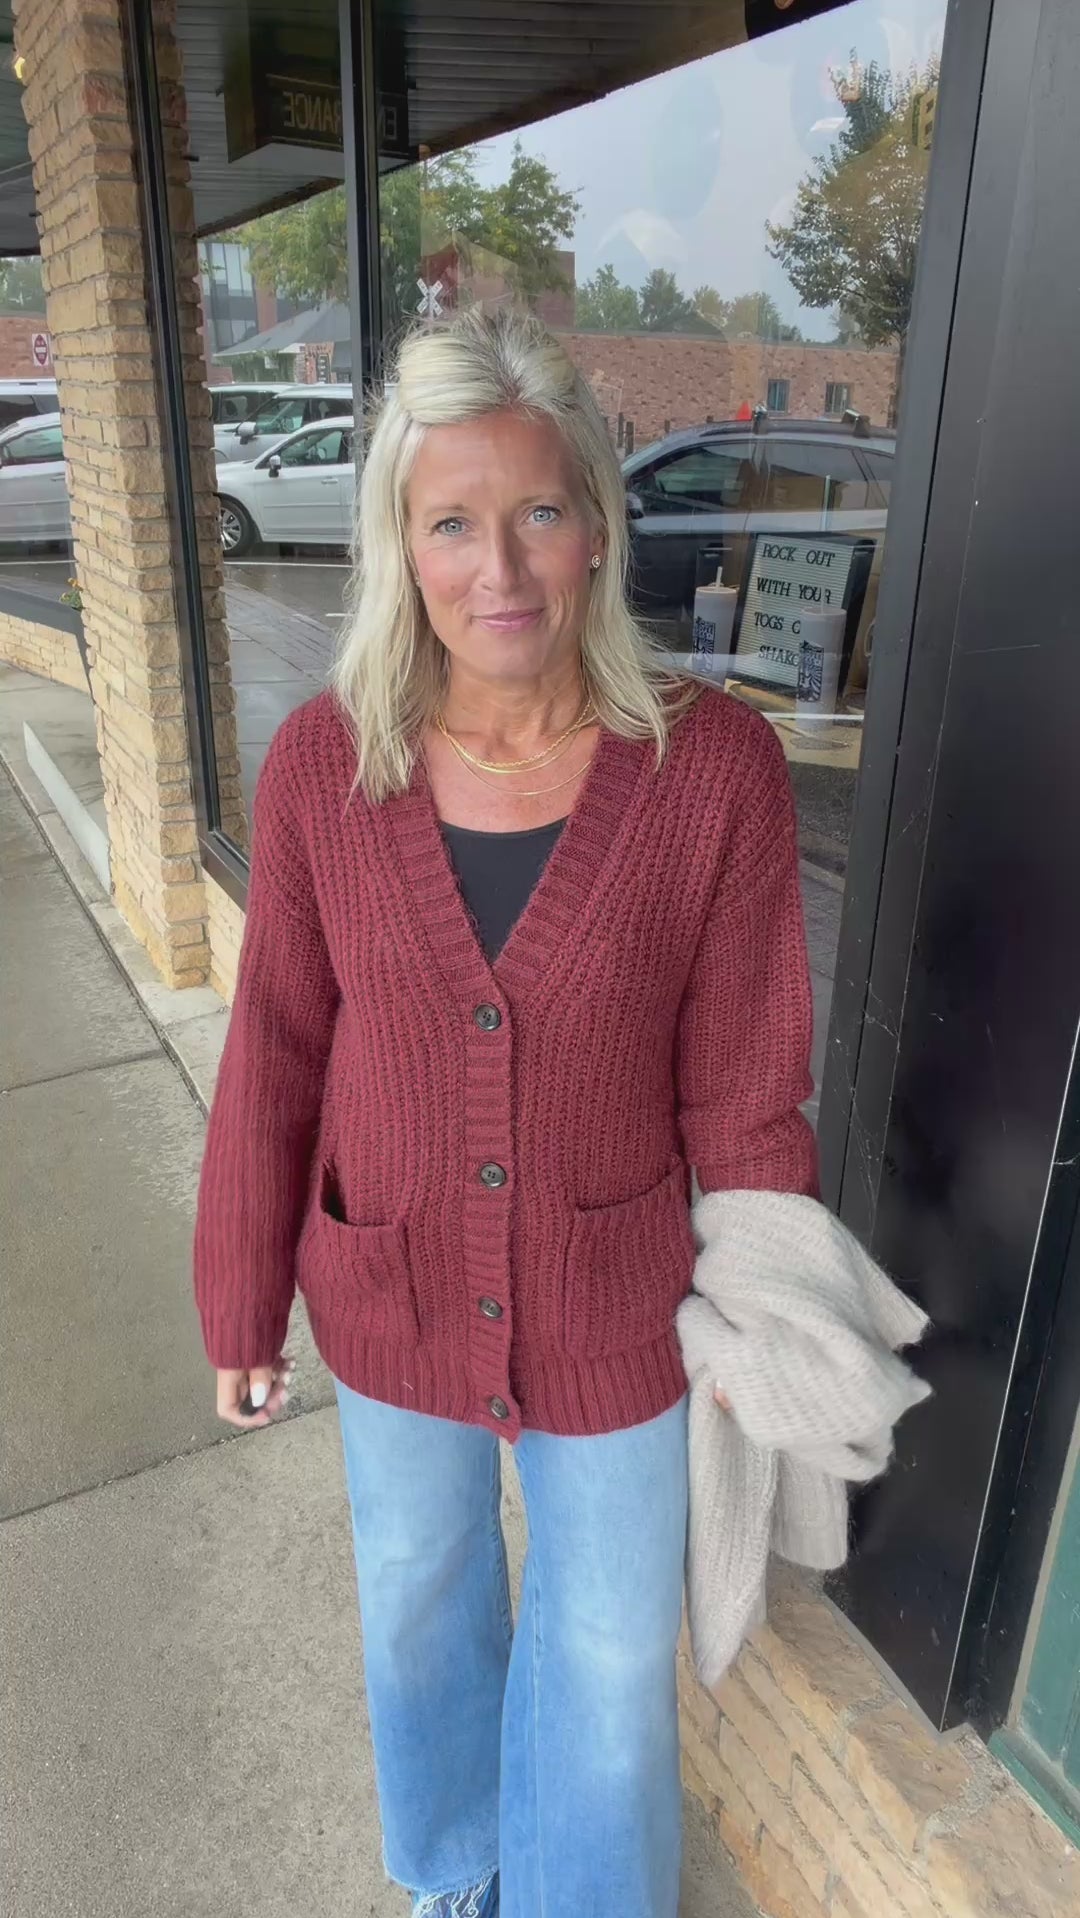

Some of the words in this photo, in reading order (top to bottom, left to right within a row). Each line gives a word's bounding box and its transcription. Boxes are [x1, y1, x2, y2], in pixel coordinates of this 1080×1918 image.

[762, 543, 797, 561] ROCK
[806, 550, 835, 567] OUT
[757, 577, 791, 596] WITH
[799, 584, 831, 604] YOUR
[754, 612, 784, 630] TOGS
[758, 645, 800, 667] SHAKO
